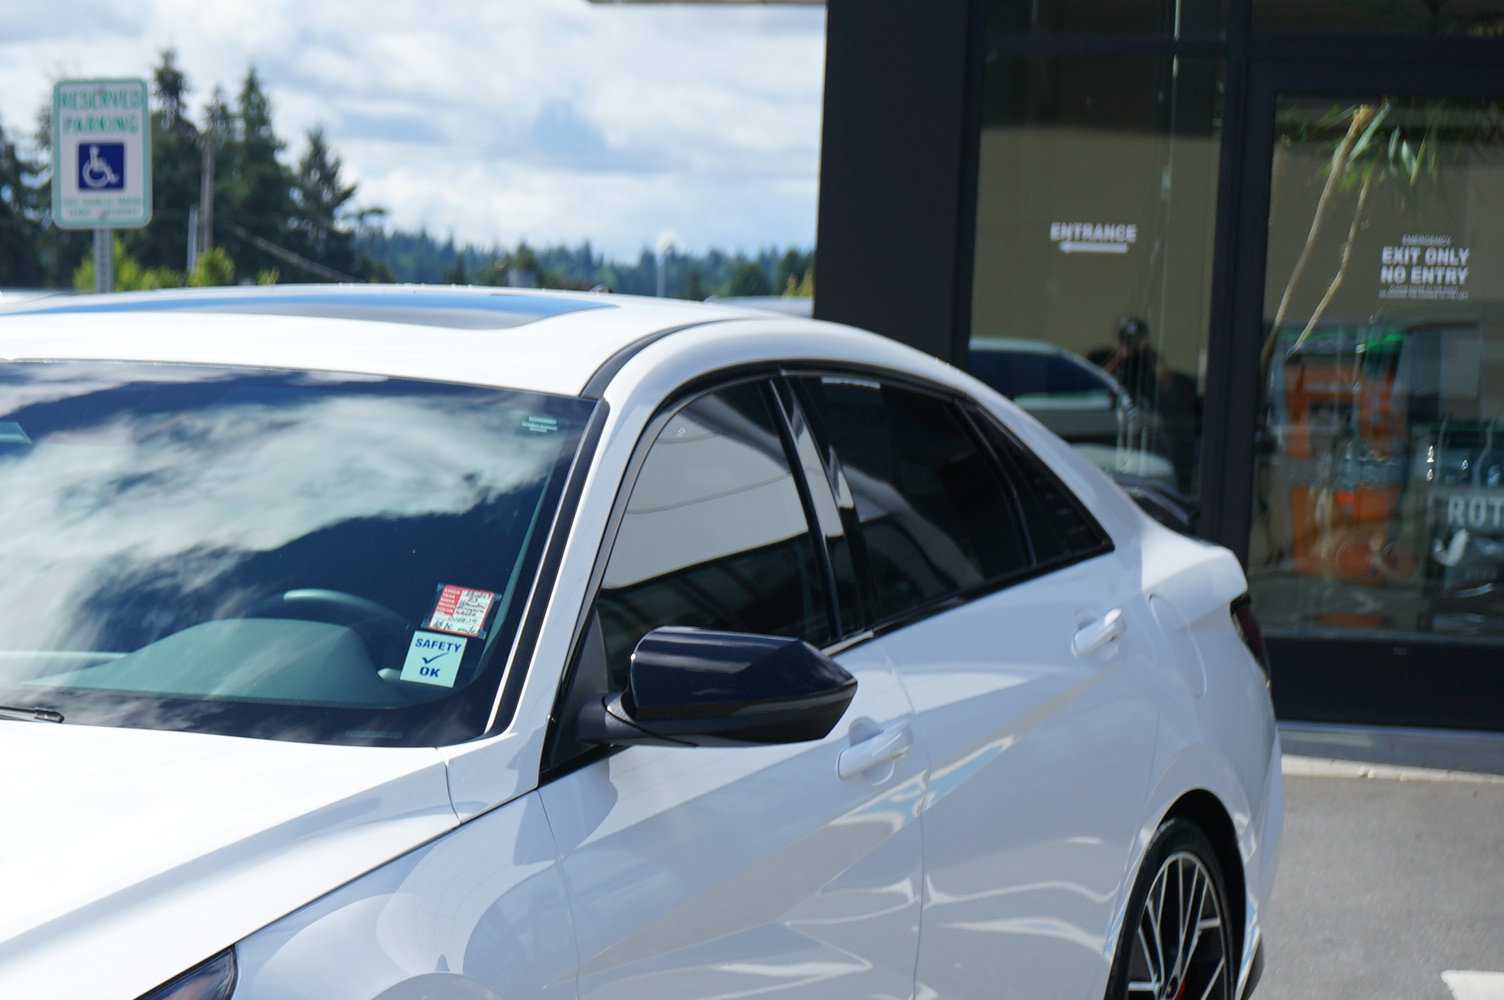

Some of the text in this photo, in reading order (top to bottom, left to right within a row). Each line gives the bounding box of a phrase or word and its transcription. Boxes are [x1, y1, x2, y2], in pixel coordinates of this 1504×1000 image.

[61, 90, 141, 109] RESERVED
[63, 116, 139, 134] PARKING
[1050, 222, 1136, 242] ENTRANCE
[1381, 246, 1471, 266] EXIT ONLY
[1380, 265, 1469, 285] NO ENTRY
[415, 638, 462, 653] SAFETY
[419, 666, 441, 678] OK
